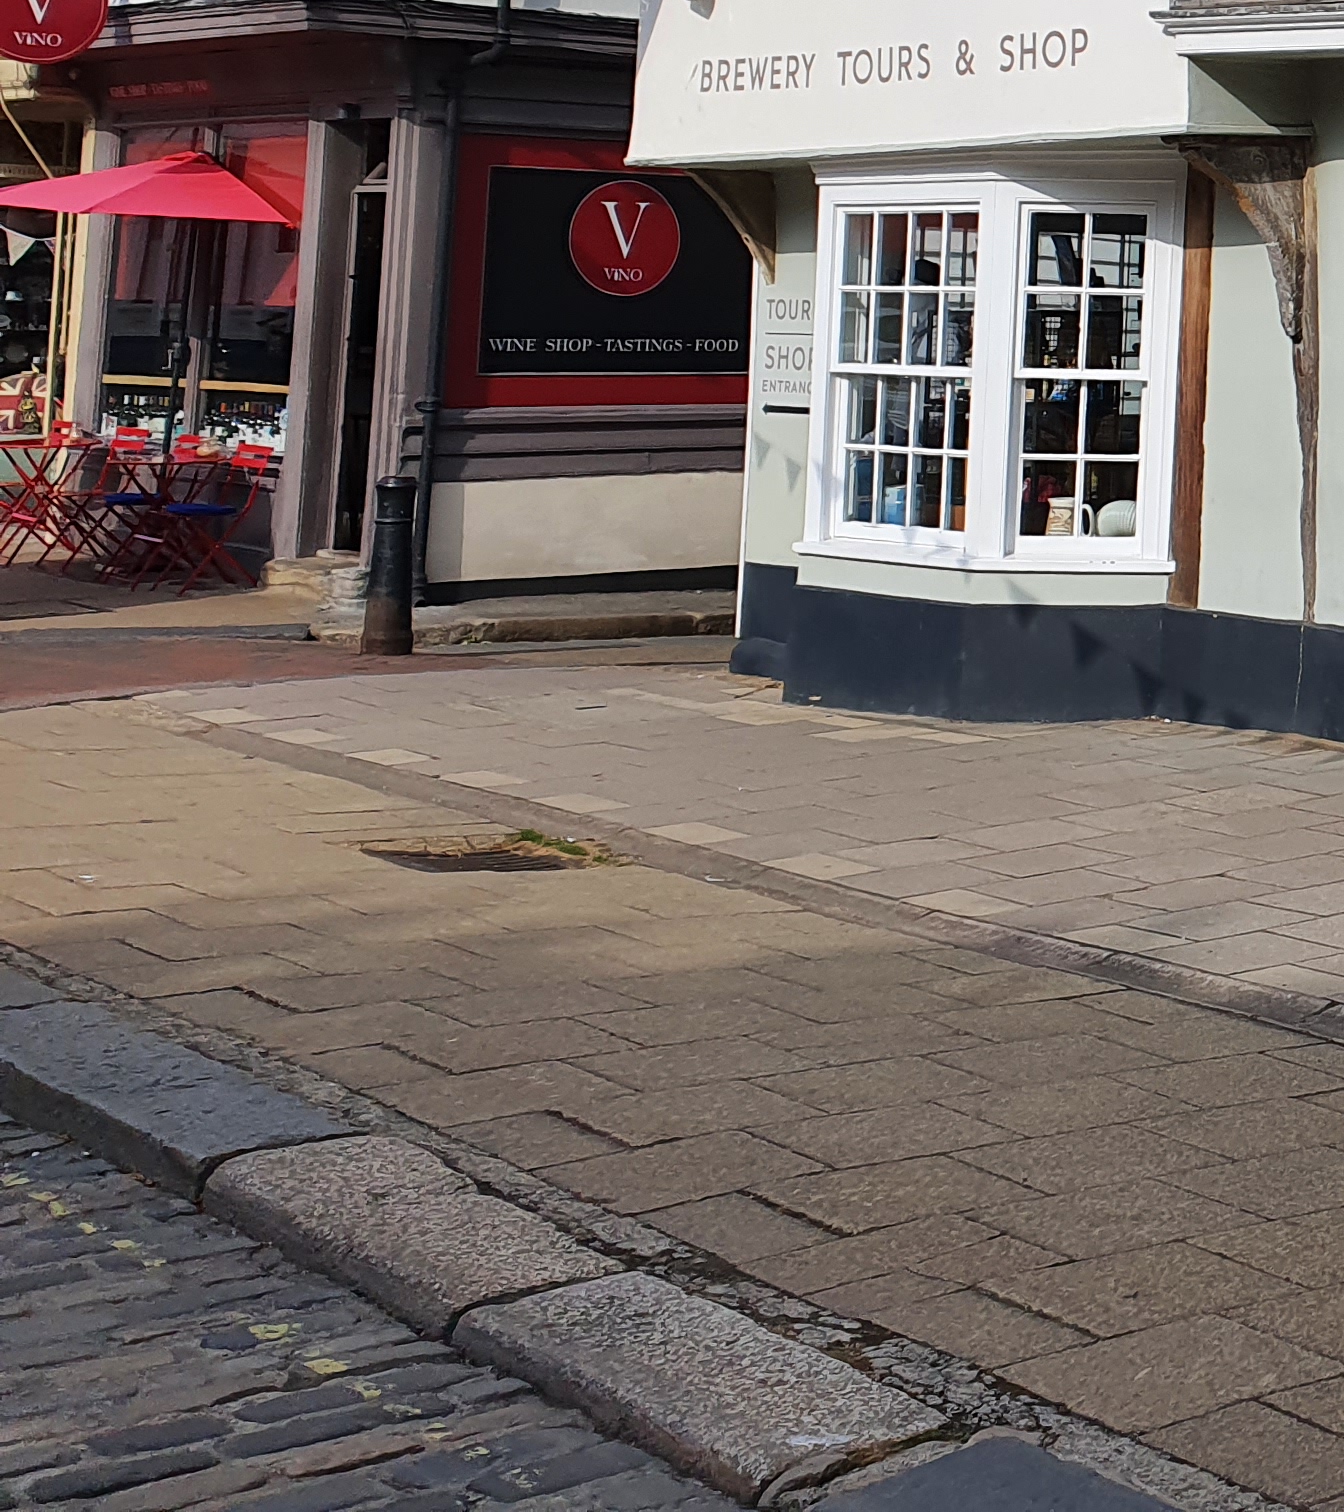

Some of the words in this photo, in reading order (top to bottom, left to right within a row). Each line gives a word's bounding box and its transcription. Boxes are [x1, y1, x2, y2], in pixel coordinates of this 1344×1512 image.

[699, 53, 816, 93] BREWERY
[836, 42, 931, 87] TOURS
[955, 39, 976, 76] &
[999, 28, 1089, 73] SHOP
[600, 201, 653, 259] V
[488, 338, 537, 352] WINE
[545, 338, 593, 352] SHOP
[603, 338, 683, 352] TASTINGS
[694, 338, 739, 352] FOOD
